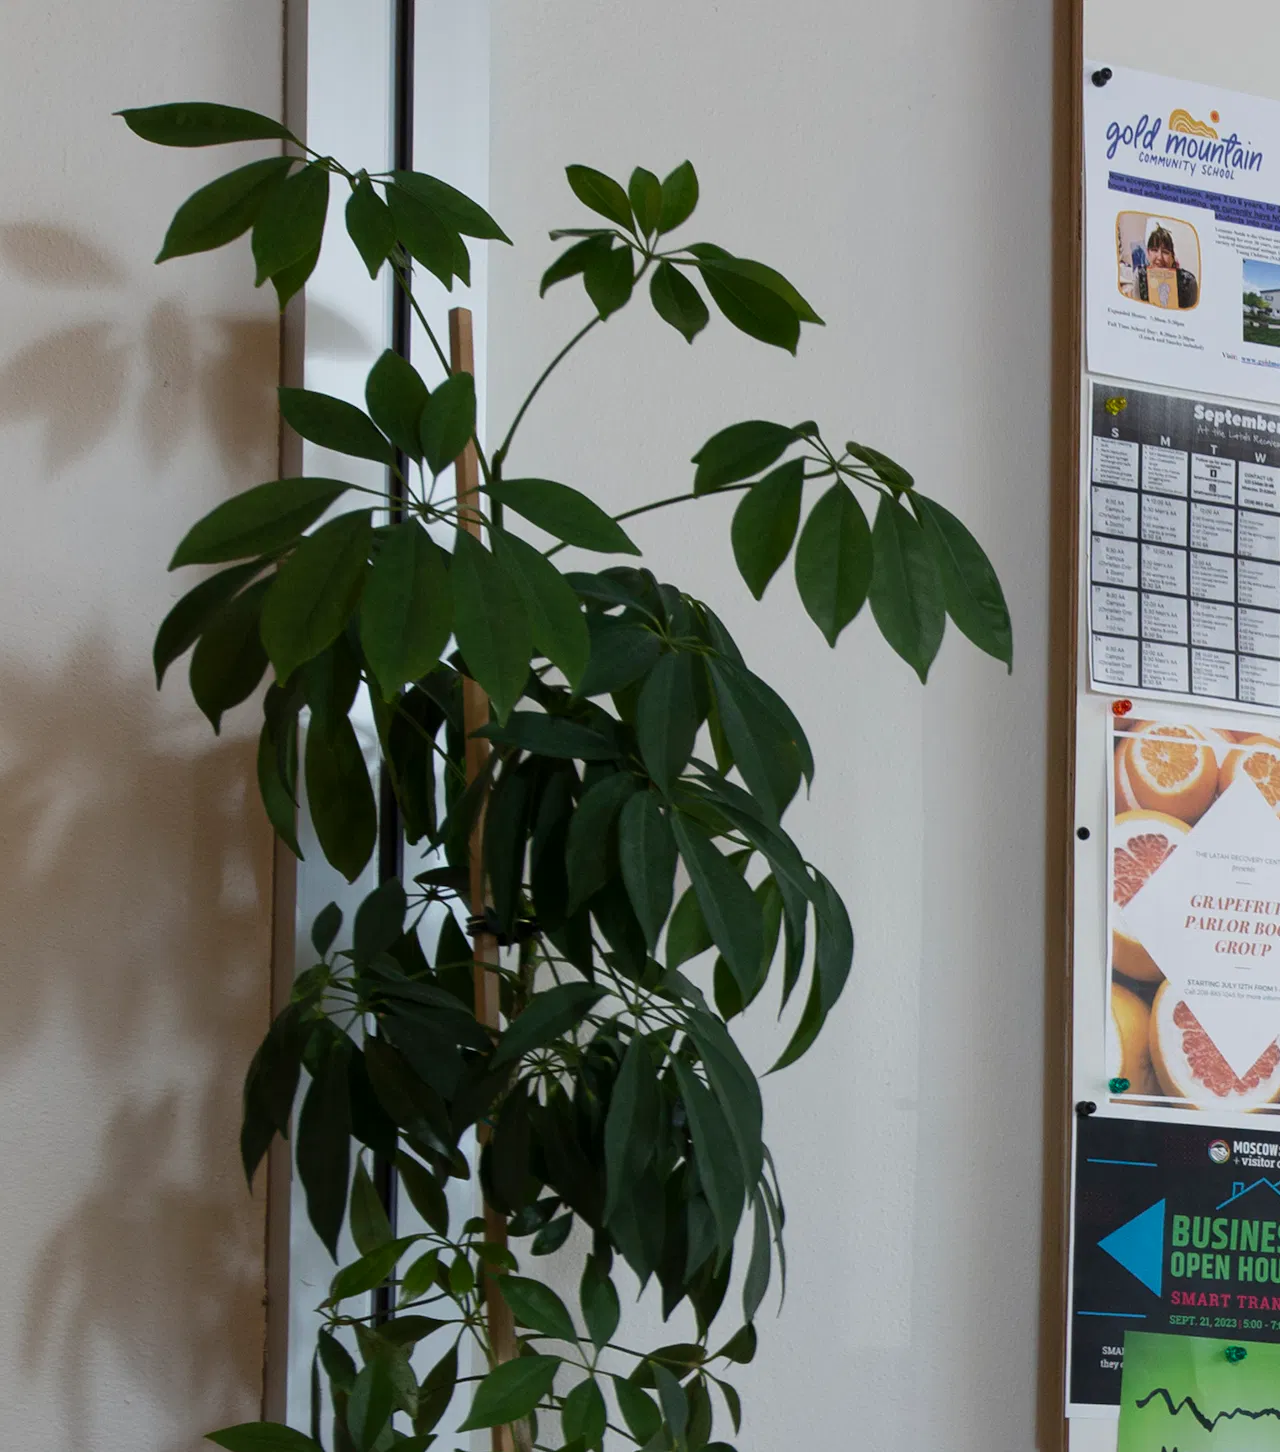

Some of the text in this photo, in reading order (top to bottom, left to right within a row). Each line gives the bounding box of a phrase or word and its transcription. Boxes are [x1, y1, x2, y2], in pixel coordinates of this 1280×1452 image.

[1106, 114, 1263, 172] gold mountain
[1138, 152, 1235, 180] COMMUNITY SCHOOL
[1184, 915, 1251, 935] PARLOR
[1215, 939, 1272, 957] GROUP
[1170, 1251, 1230, 1280] OPEN
[1171, 1291, 1232, 1308] SMART
